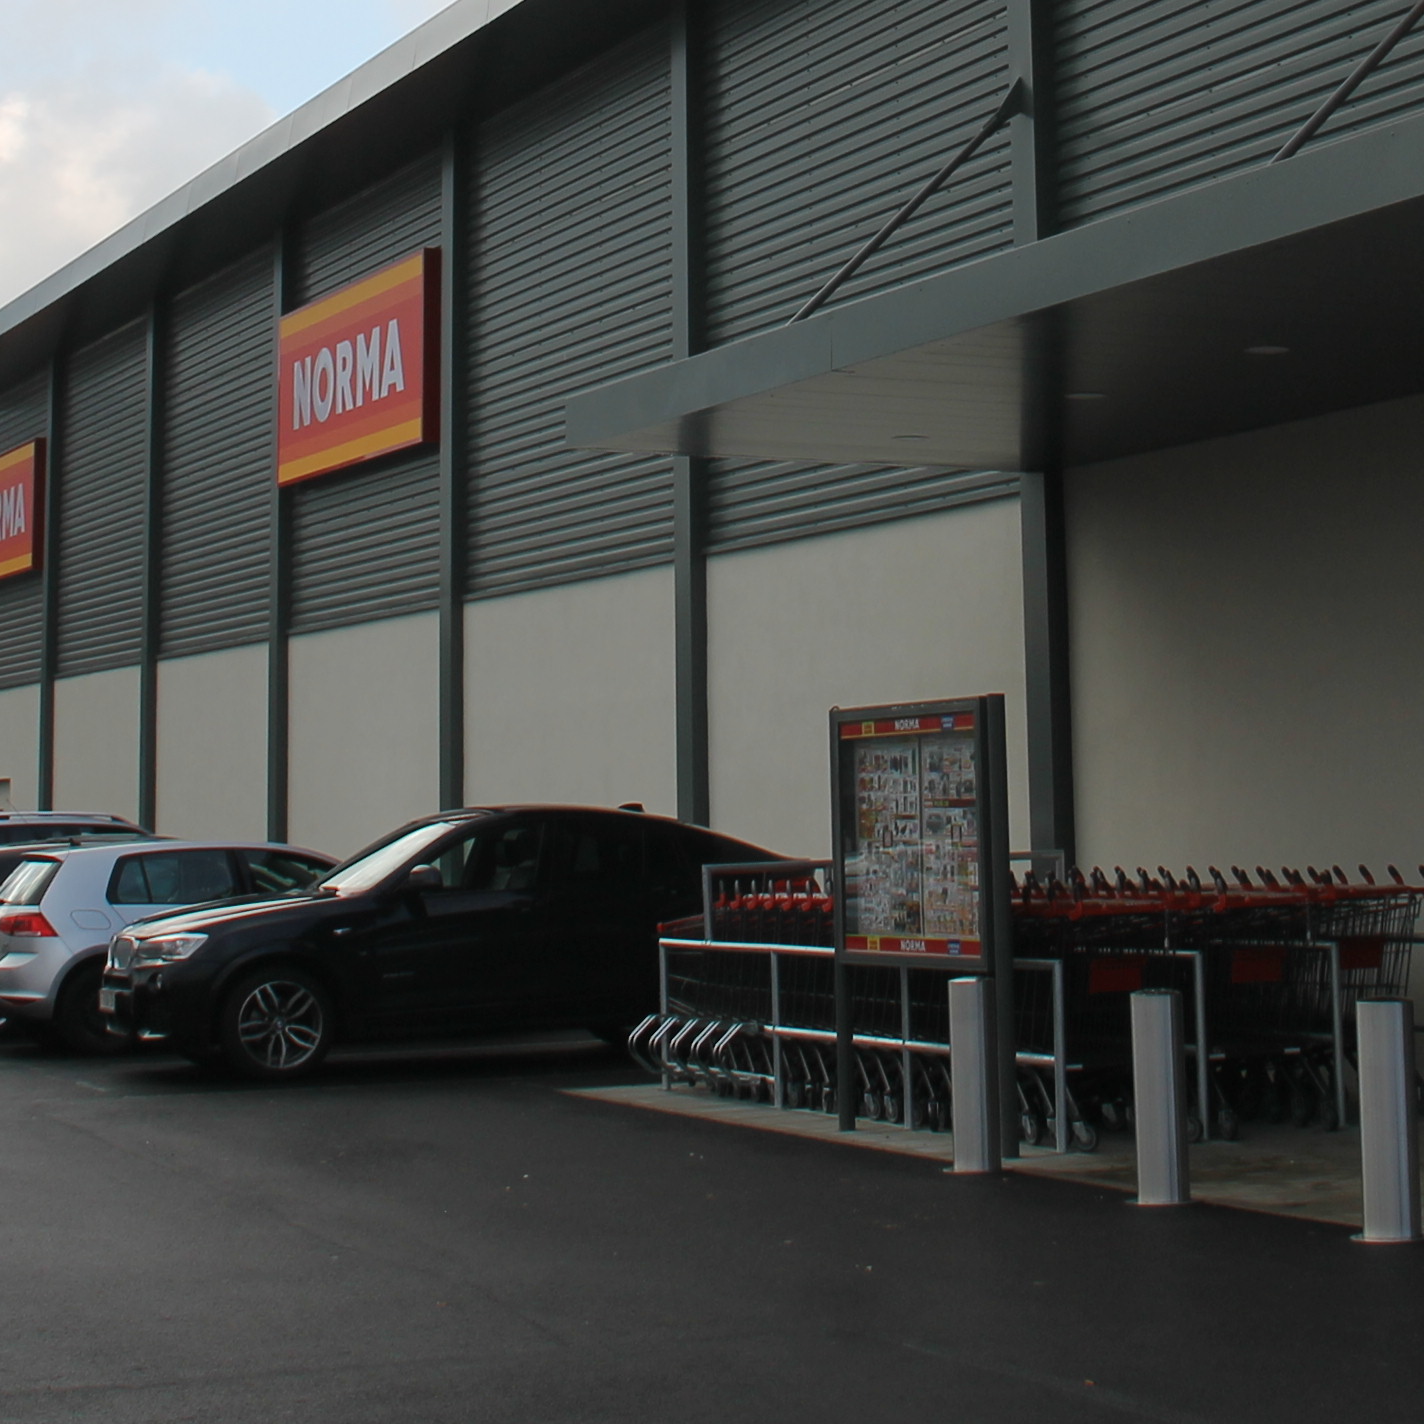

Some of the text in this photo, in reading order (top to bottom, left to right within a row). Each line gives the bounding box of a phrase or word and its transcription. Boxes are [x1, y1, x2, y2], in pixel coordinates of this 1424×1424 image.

[293, 318, 404, 430] NORMA
[895, 718, 920, 731] NORMA
[900, 939, 926, 952] NORMA
